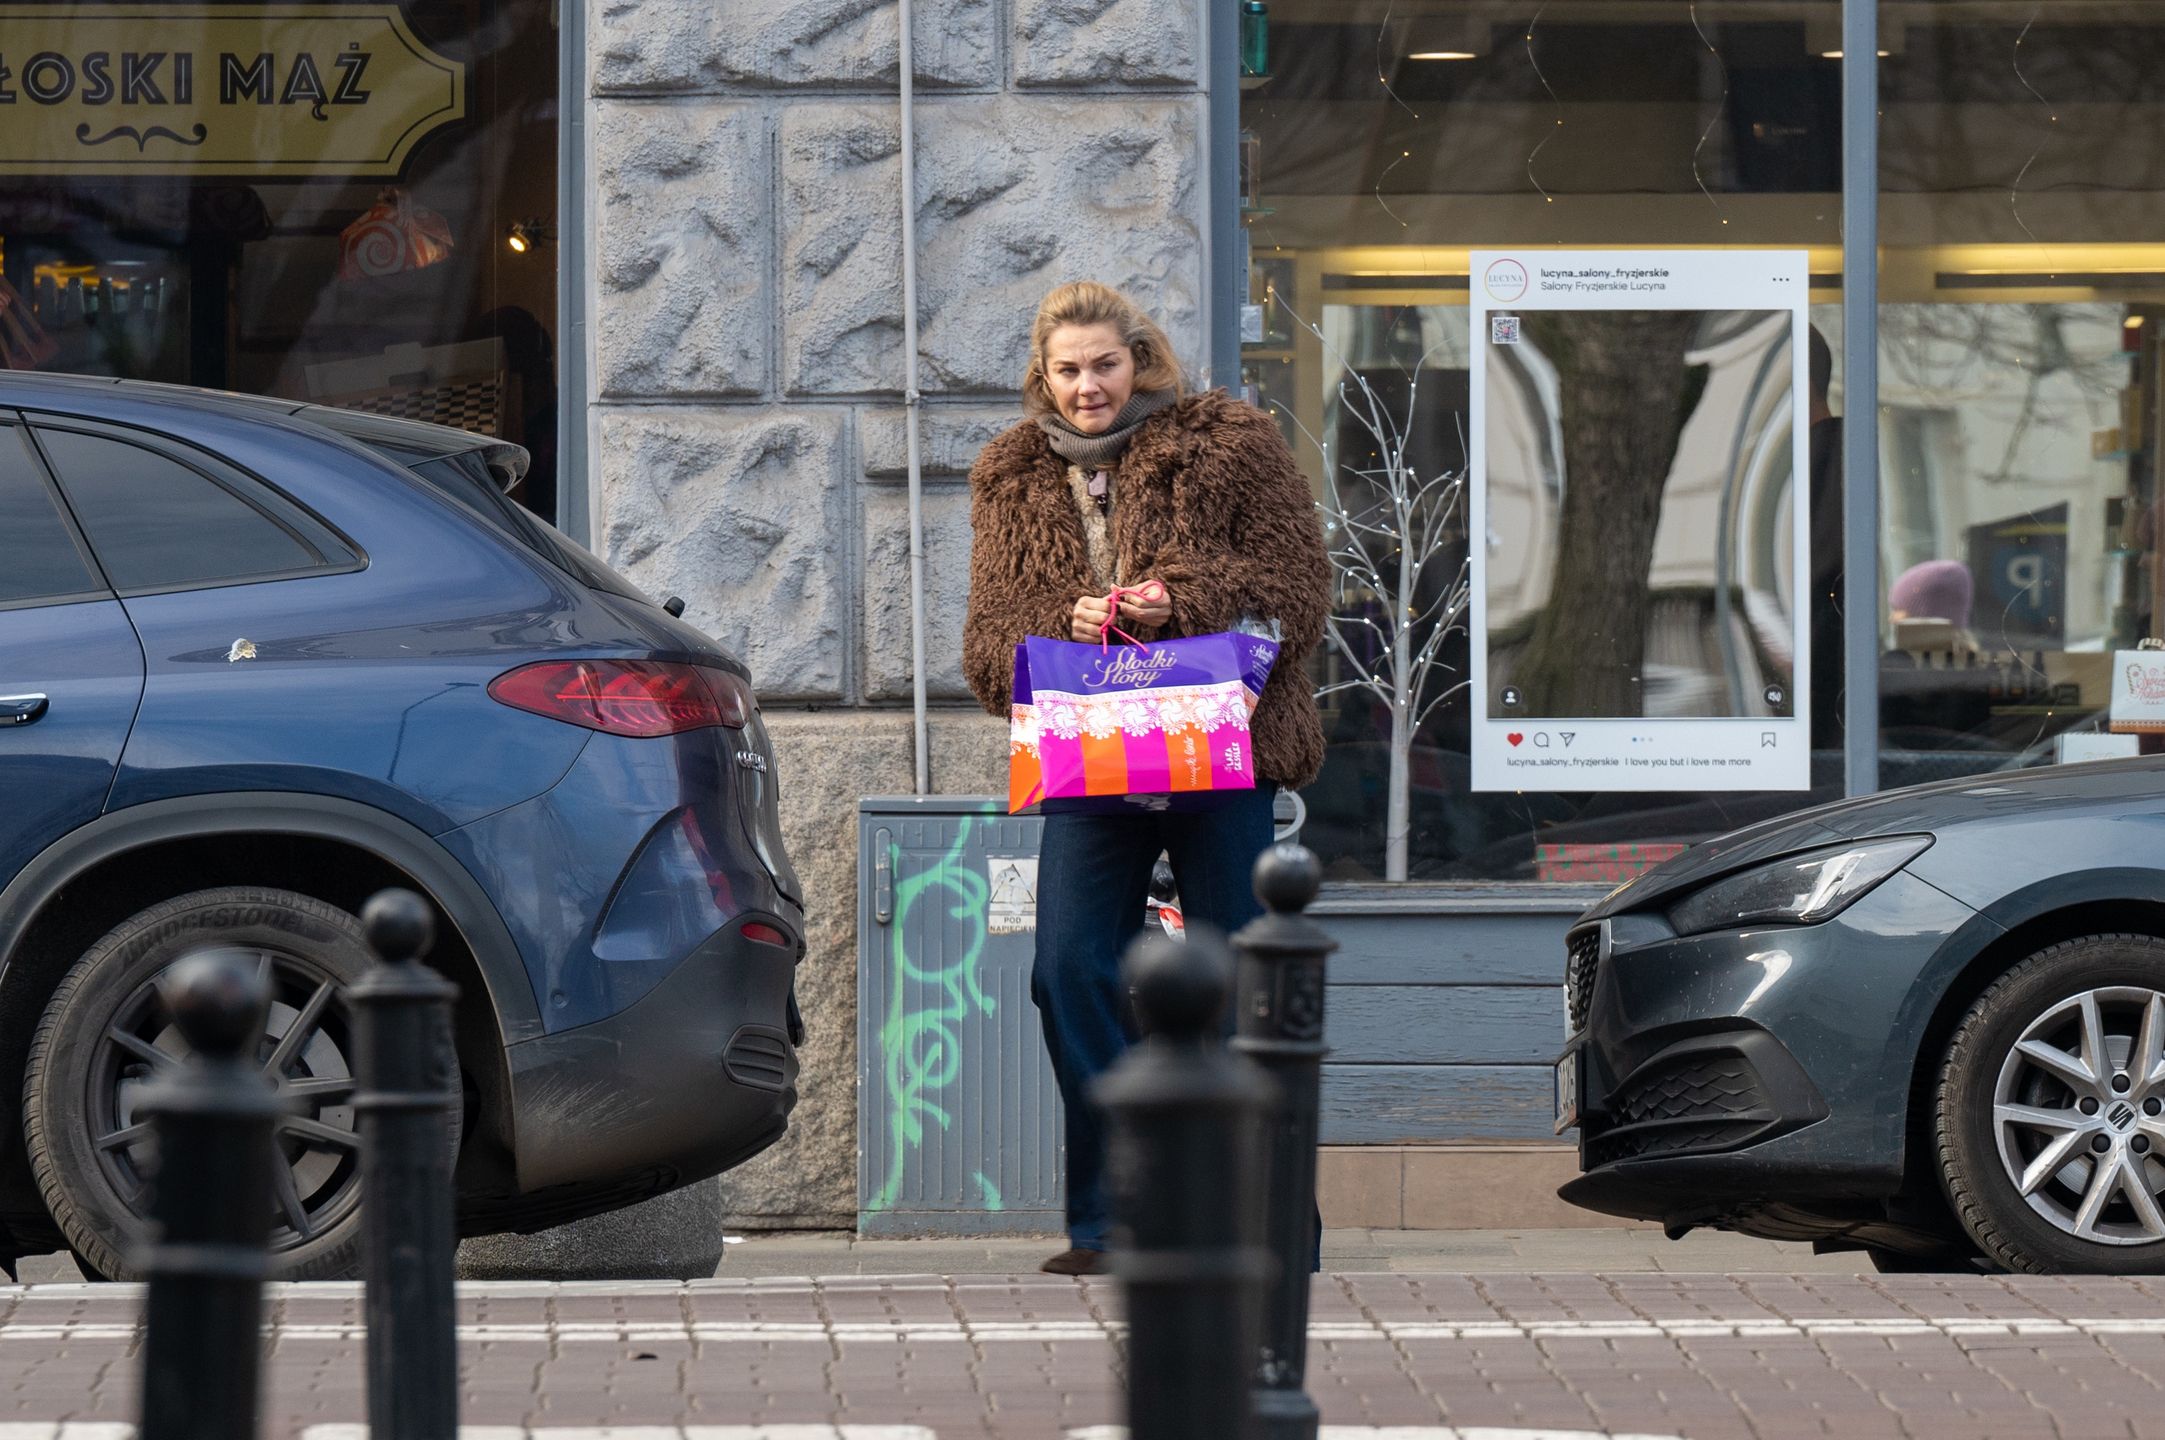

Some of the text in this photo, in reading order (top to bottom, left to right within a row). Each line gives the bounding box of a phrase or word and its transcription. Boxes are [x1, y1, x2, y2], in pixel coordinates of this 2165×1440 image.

[219, 42, 373, 121] MĄŻ
[1488, 274, 1523, 283] LUCYNA
[1540, 268, 1669, 280] lucyna_salony_fryzjerskie
[1540, 281, 1666, 292] Salony Fryzjerskie Lucyna
[1506, 757, 1619, 768] lucyna_salony_fryzjerskie
[1630, 757, 1649, 766] love
[1651, 759, 1668, 768] you
[1669, 757, 1684, 766] but
[1691, 757, 1710, 766] love
[1003, 916, 1022, 924] POD
